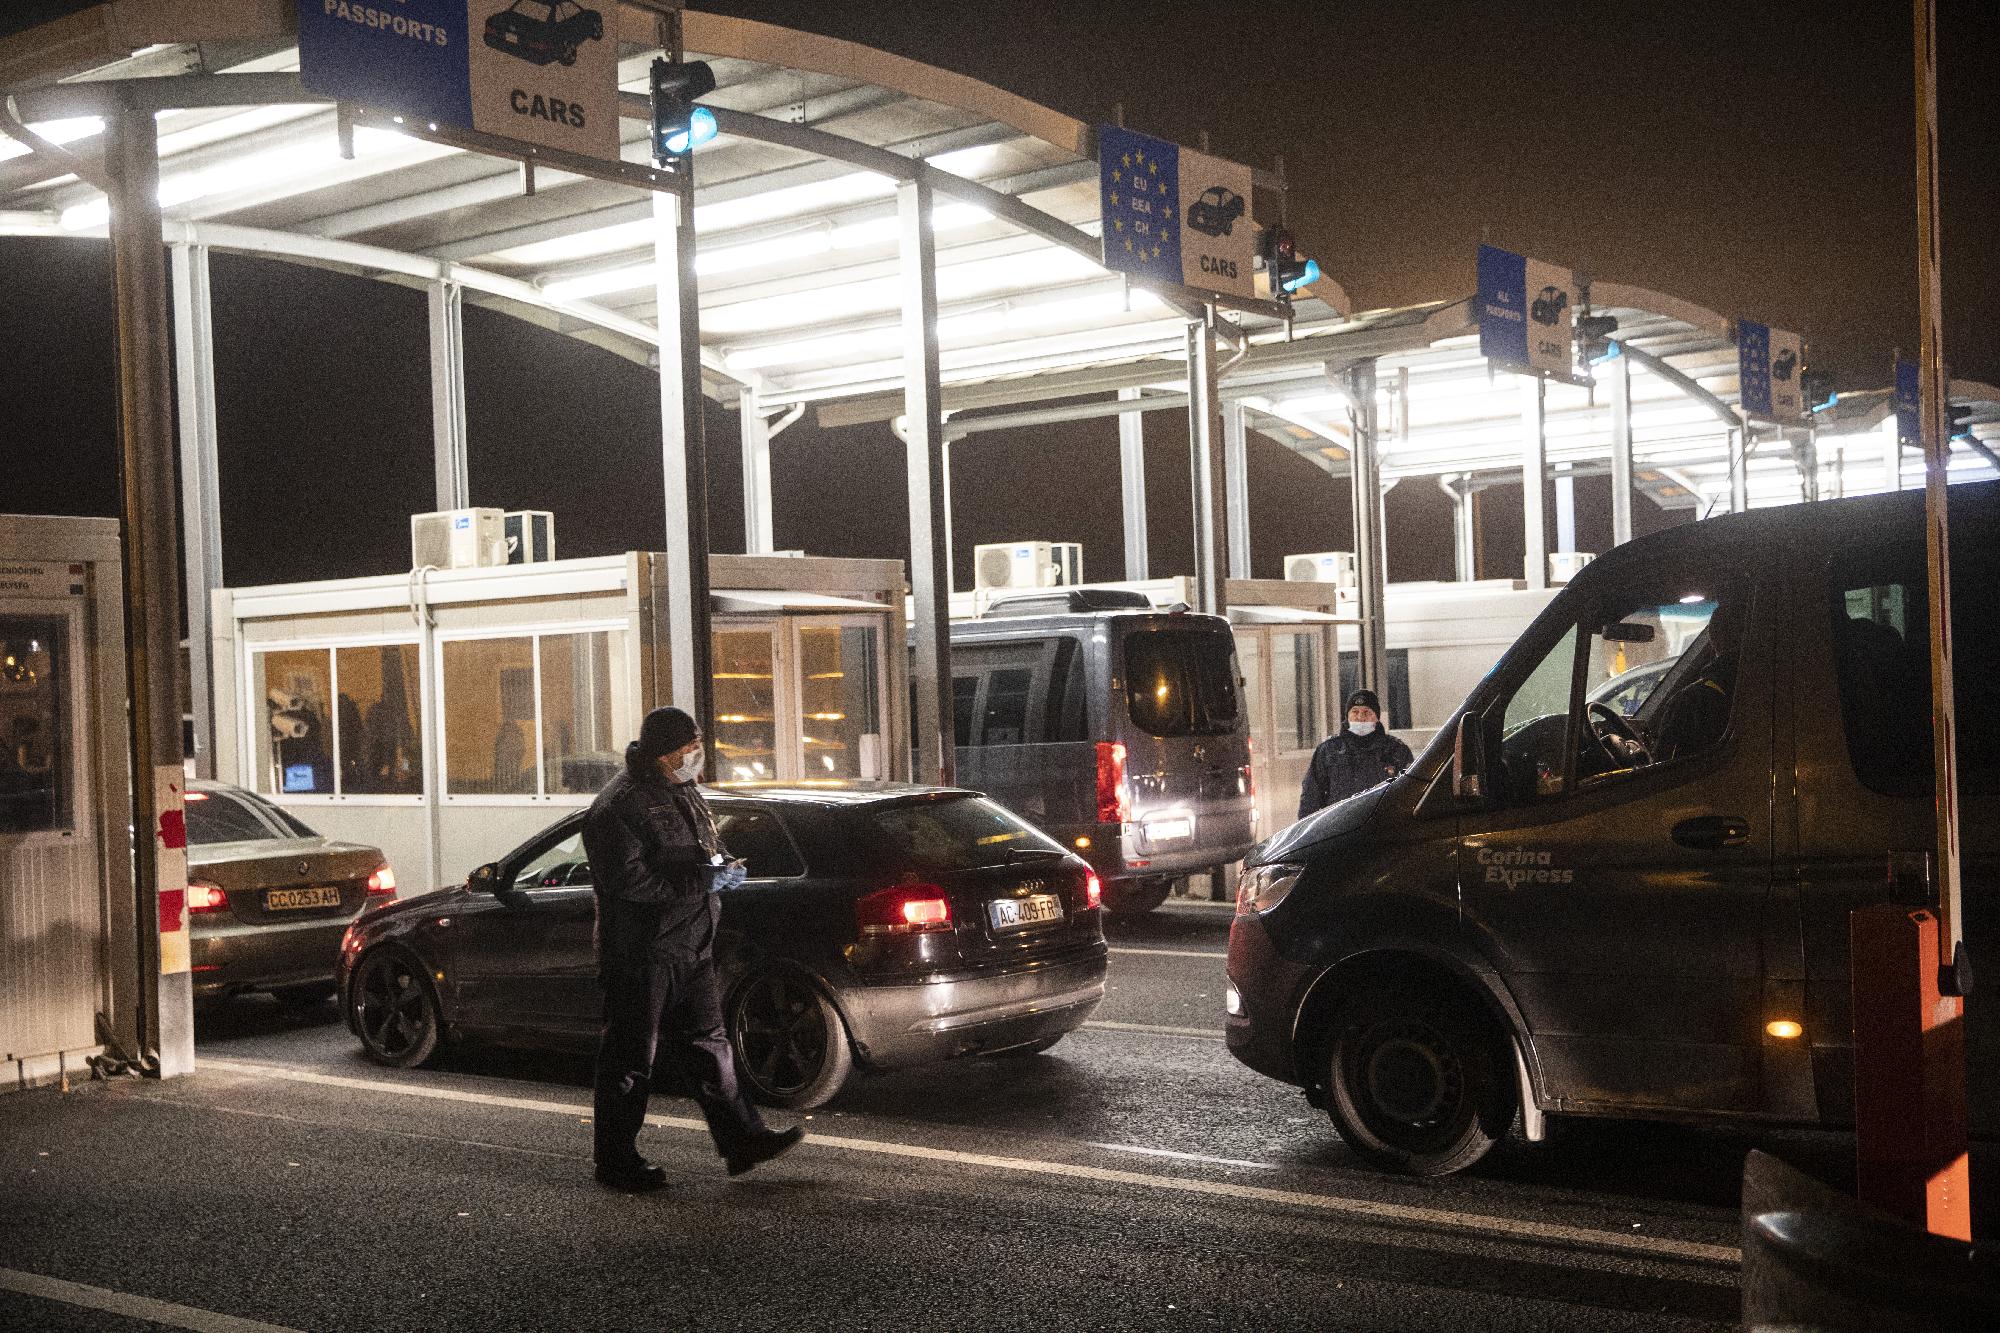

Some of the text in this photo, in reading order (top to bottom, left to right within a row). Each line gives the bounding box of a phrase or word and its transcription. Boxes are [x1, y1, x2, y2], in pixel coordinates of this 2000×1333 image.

[324, 0, 448, 46] PASSPORTS
[511, 89, 586, 129] CARS
[1133, 175, 1148, 192] EU
[1200, 254, 1238, 280] CARS
[1484, 866, 1574, 891] Express
